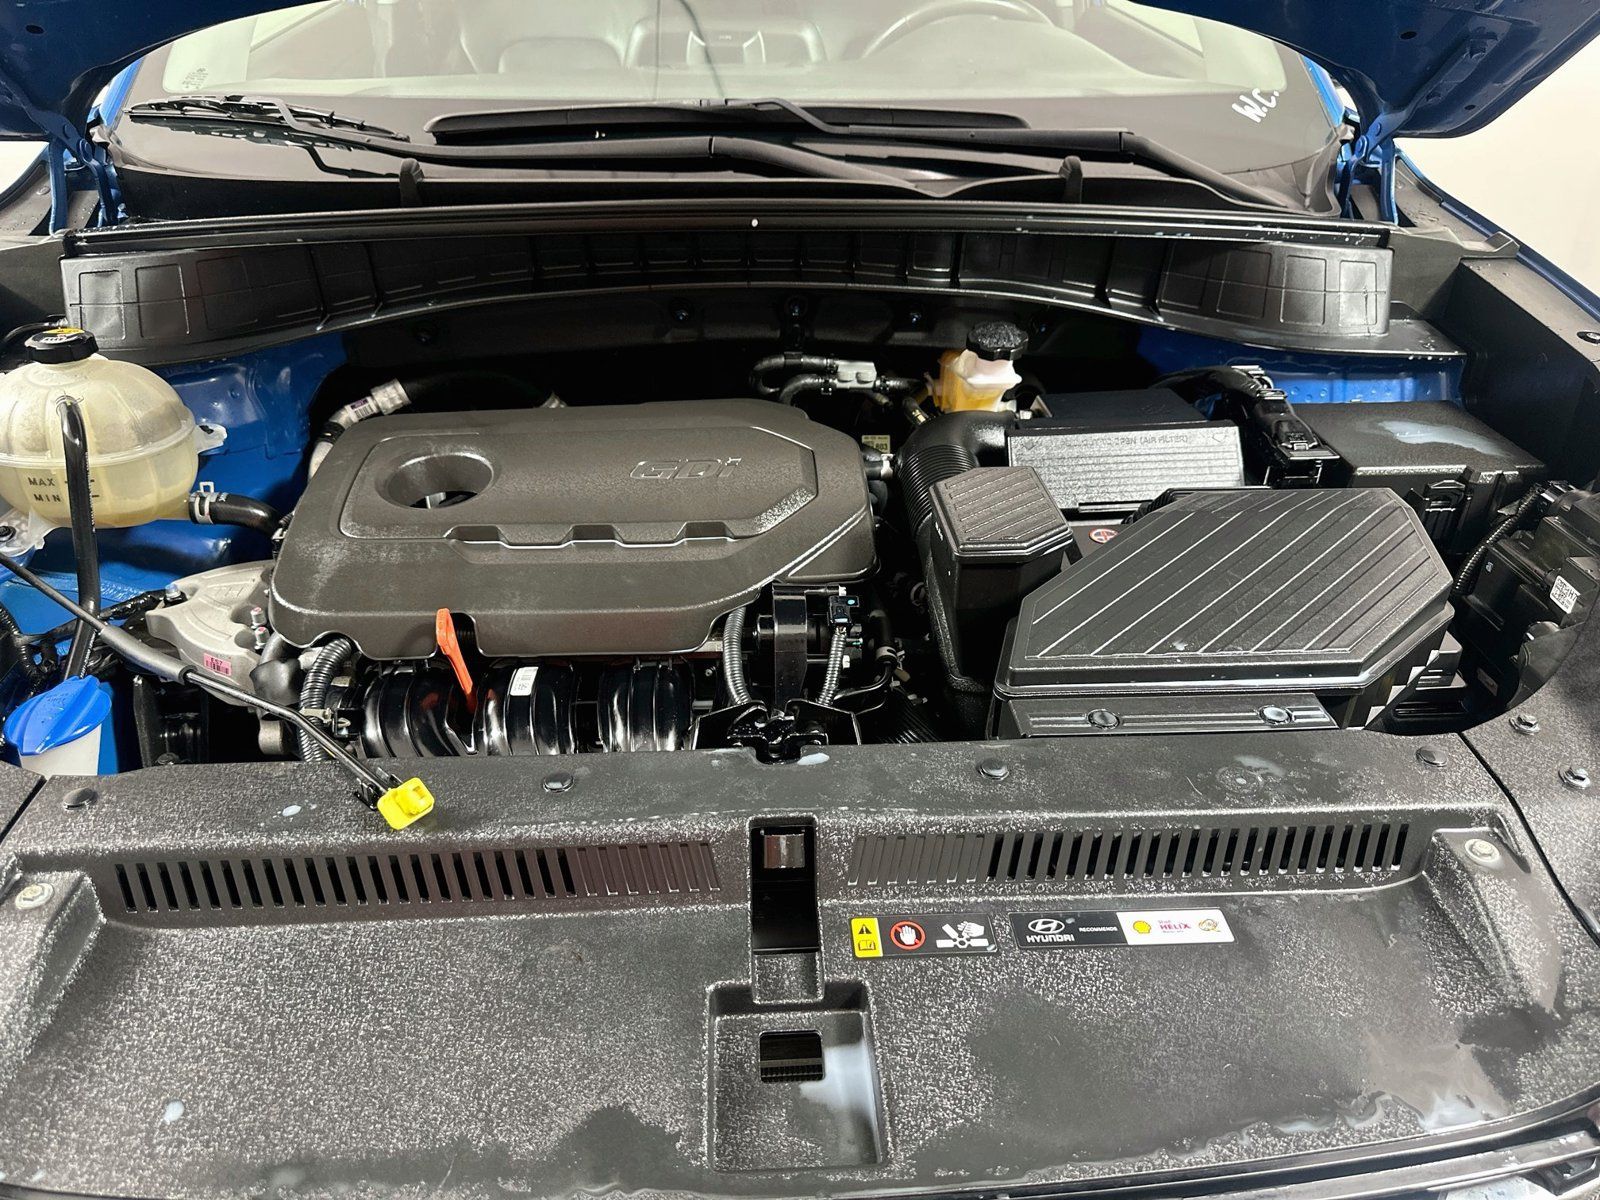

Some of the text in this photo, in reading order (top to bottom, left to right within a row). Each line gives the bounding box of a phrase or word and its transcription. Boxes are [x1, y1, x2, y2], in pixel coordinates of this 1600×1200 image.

[1231, 87, 1280, 123] W.C.
[629, 457, 742, 479] GDi
[27, 477, 55, 486] MAX
[33, 493, 61, 502] MIN
[1026, 934, 1075, 943] HYUNDAI
